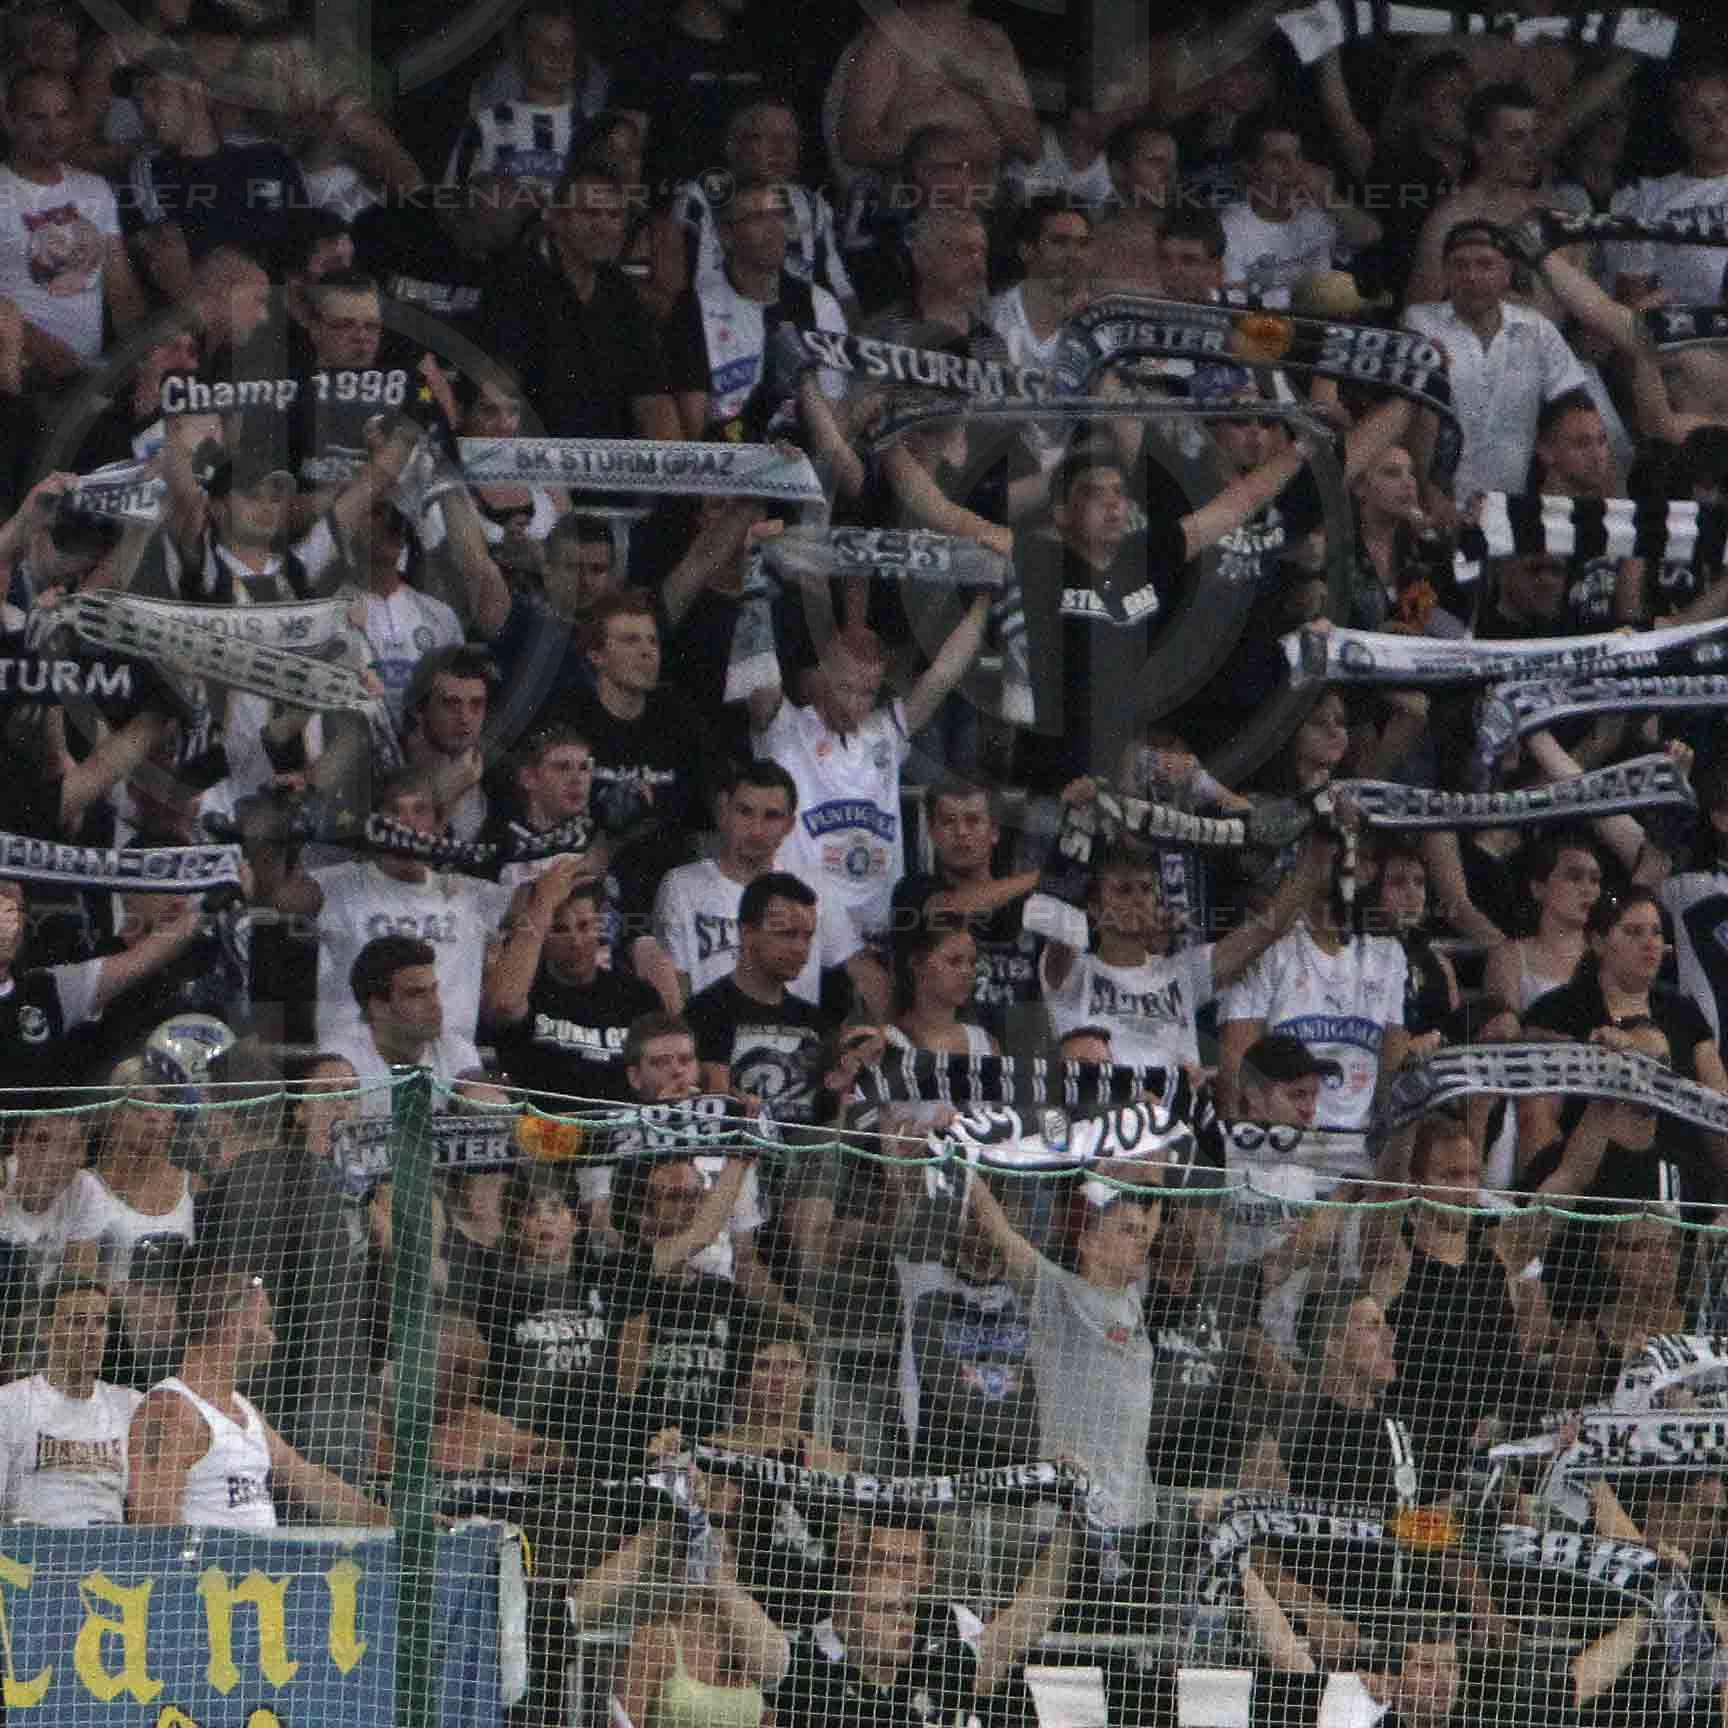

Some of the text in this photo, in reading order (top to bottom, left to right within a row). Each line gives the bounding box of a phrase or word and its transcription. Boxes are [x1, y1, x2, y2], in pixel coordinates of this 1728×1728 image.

[158, 370, 407, 415] Champ 1998
[558, 450, 659, 476] STURM
